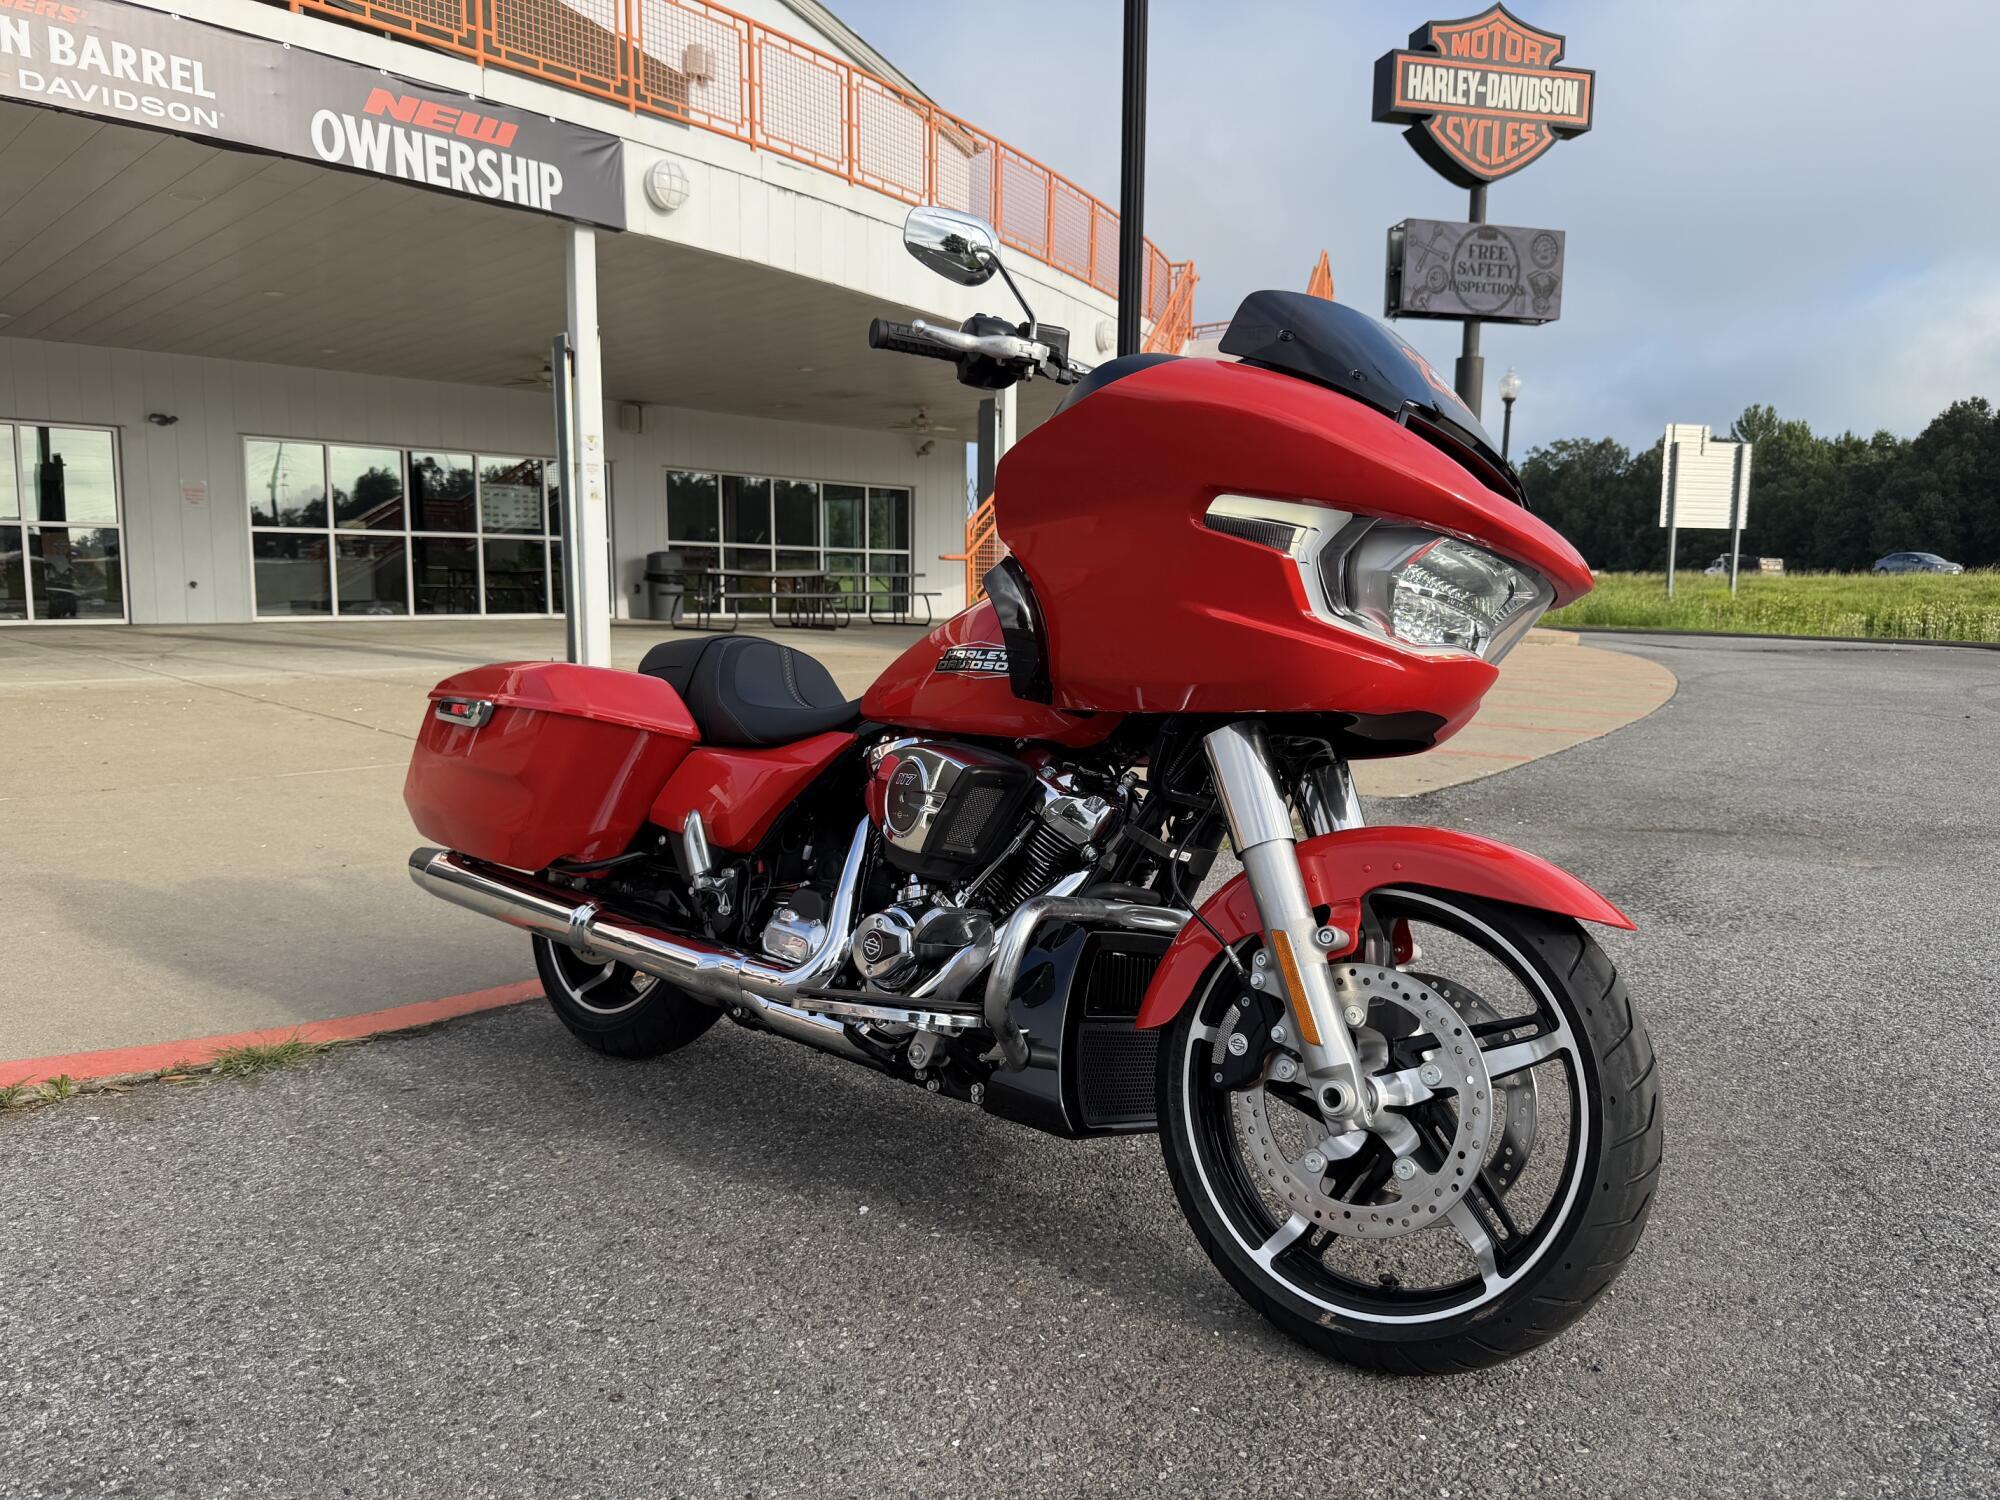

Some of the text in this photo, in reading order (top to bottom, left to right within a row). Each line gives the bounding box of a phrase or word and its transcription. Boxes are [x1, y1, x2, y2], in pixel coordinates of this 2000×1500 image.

[48, 25, 216, 100] BARREL
[1452, 21, 1542, 65] MOTOR
[18, 68, 219, 129] DAVIDSON
[1407, 64, 1578, 115] HARLEY-DAVIDSON
[363, 87, 519, 148] NEW
[310, 109, 563, 211] OWNERSHIP
[1446, 117, 1537, 165] CYCLES
[1457, 261, 1516, 279] SAFETY
[1469, 243, 1509, 261] FREE
[1448, 279, 1525, 297] INSPECTIONS
[938, 660, 1009, 671] DAVIDSO
[946, 650, 1008, 660] HARLEY
